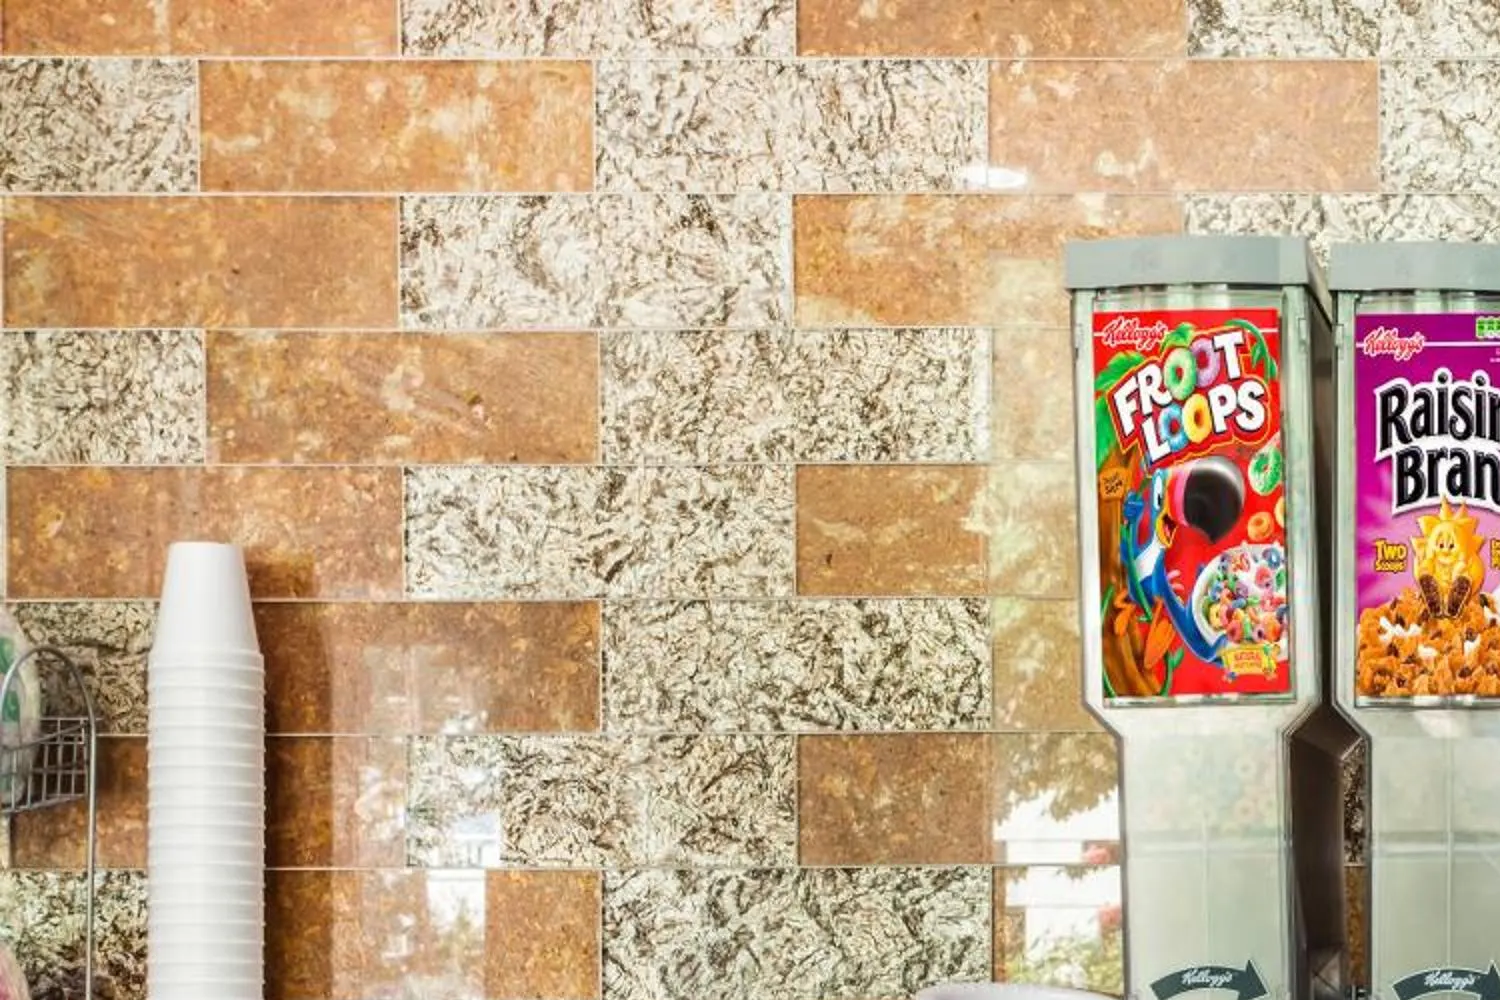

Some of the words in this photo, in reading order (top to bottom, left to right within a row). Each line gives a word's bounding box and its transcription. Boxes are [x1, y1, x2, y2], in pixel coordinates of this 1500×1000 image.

[1102, 317, 1168, 350] Kellogg's
[1363, 326, 1425, 361] Kellogg's
[1113, 331, 1245, 436] FROOT
[1141, 379, 1265, 462] LOOPS
